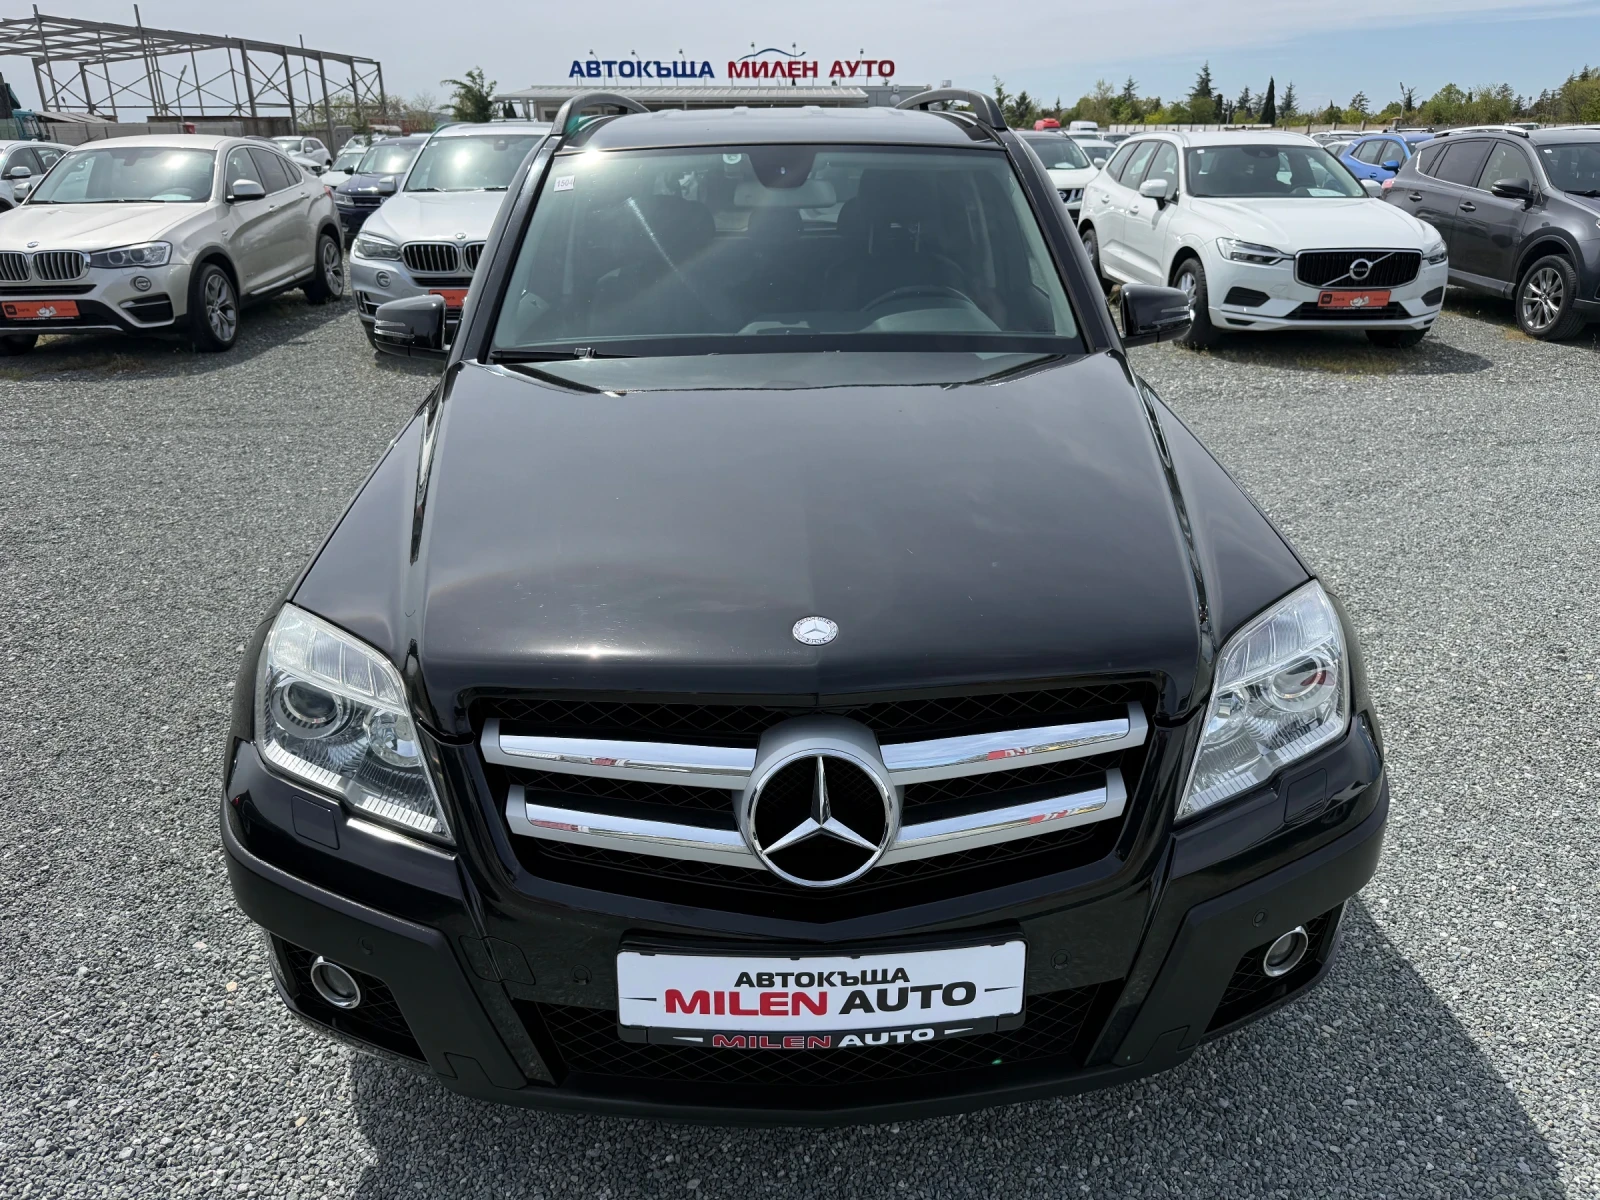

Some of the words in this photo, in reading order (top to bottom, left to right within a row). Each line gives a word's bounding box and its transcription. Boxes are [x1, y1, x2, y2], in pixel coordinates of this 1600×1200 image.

[569, 60, 715, 79] АВТОКЪЩА
[728, 61, 818, 79] МИЛЕН
[828, 60, 895, 78] АУТО
[734, 967, 910, 987] АВТОКЪЩА
[664, 988, 828, 1016] MILEN
[838, 981, 977, 1015] AUTO
[712, 1034, 832, 1049] MILEN
[837, 1028, 935, 1047] AUTO
